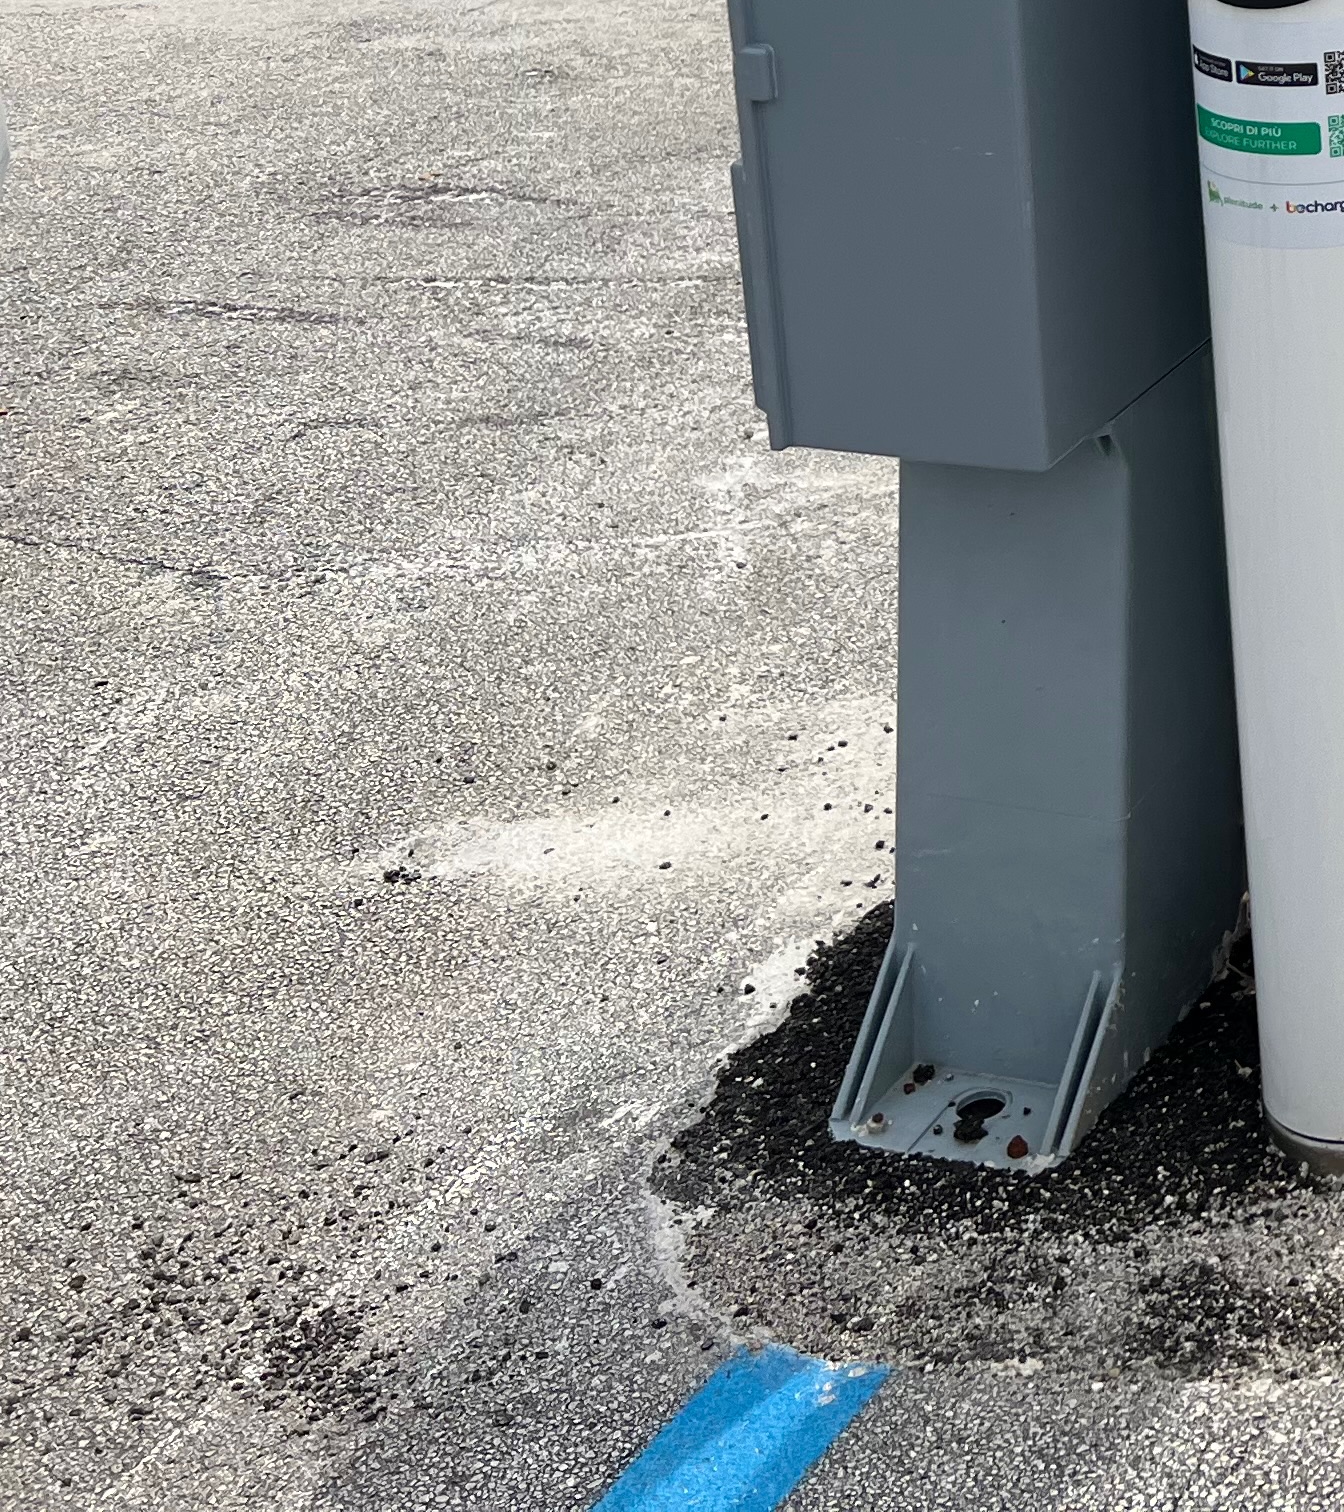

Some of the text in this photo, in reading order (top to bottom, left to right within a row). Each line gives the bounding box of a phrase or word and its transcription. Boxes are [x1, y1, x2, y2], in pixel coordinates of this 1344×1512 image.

[1258, 72, 1314, 84] Google Play
[1211, 117, 1282, 137] SCOPRI DI PIÙ
[1243, 138, 1297, 150] FURTHER
